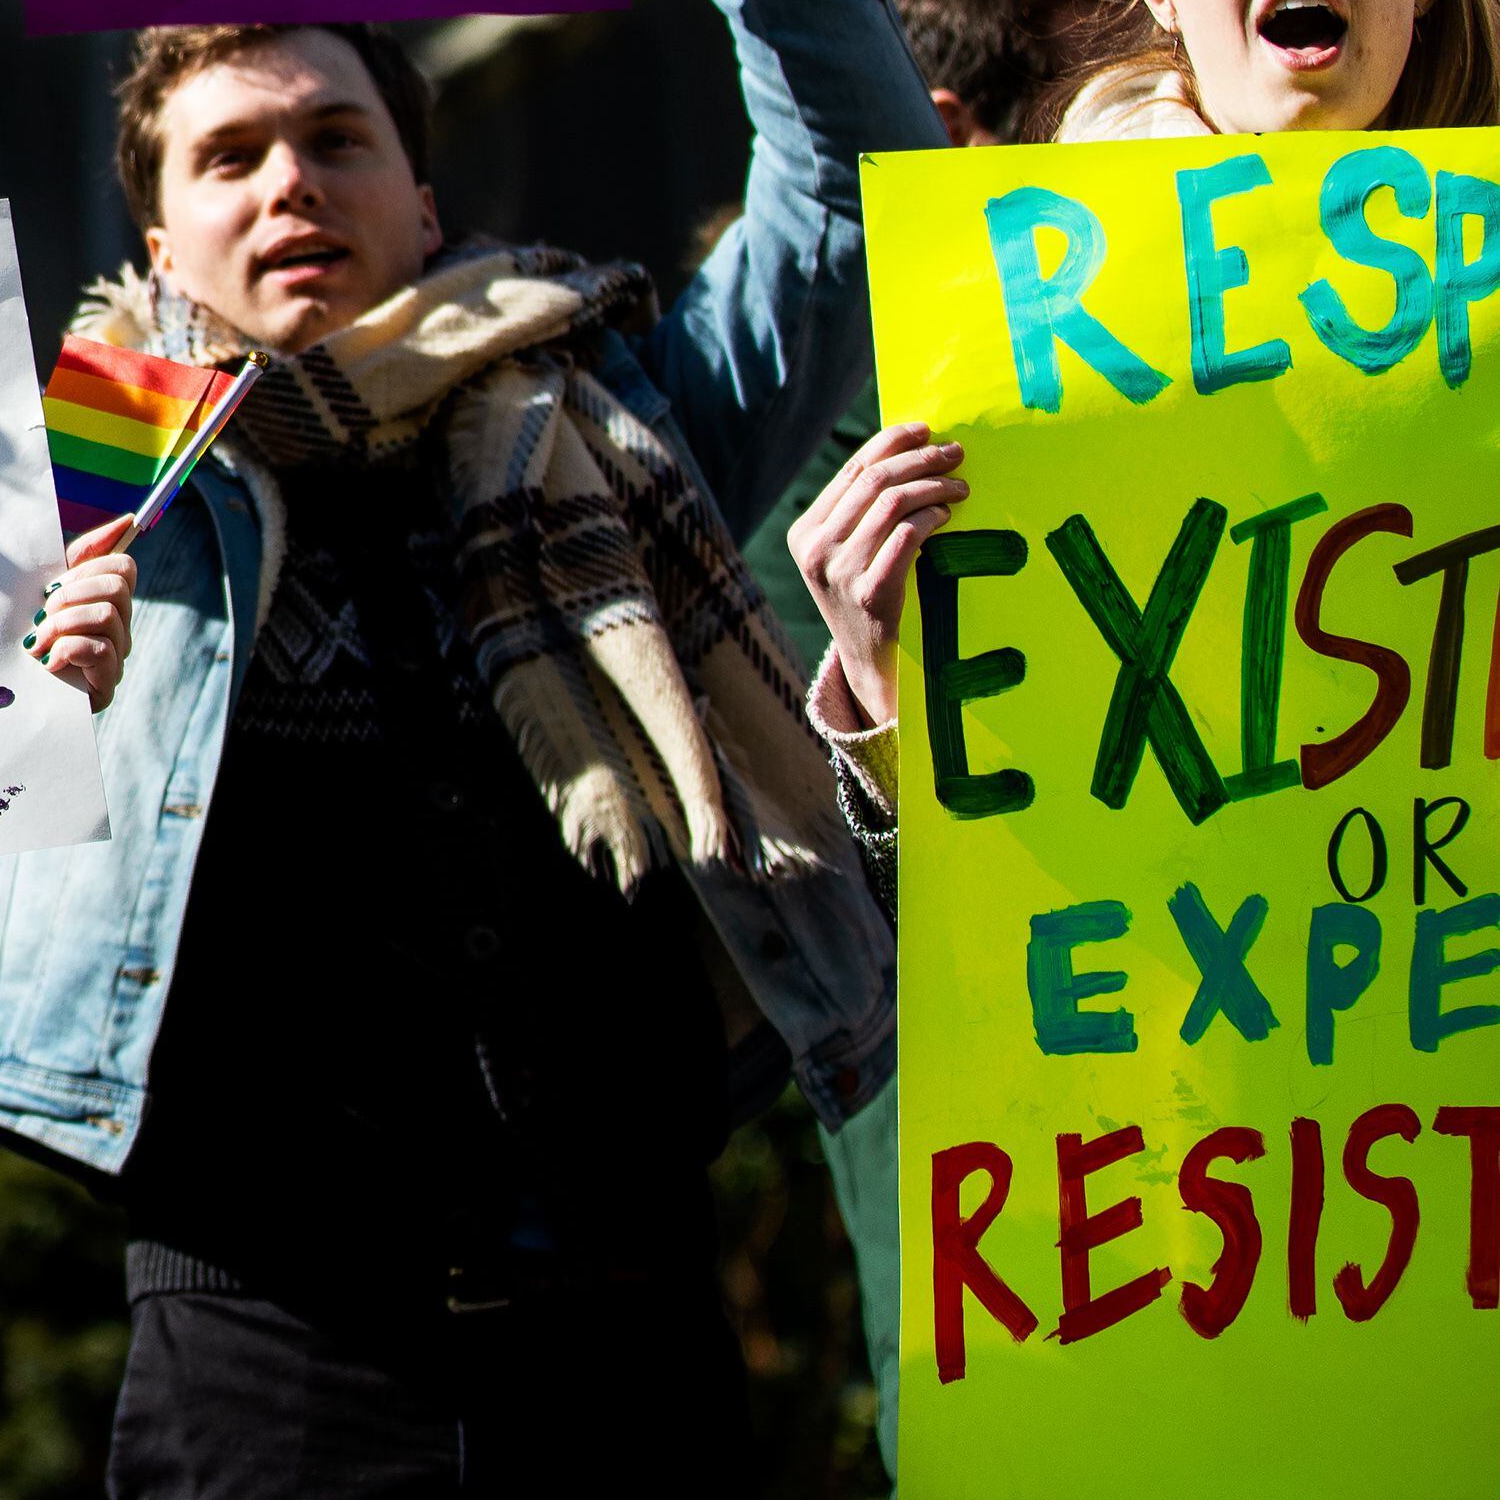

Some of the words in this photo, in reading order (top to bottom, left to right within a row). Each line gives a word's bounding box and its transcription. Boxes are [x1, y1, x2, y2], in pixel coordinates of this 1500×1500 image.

[984, 145, 1500, 414] RESP
[915, 492, 1500, 826] EXIST
[1027, 881, 1500, 1066] EXPE
[1327, 796, 1471, 906] OR
[931, 1103, 1500, 1385] RESIST
